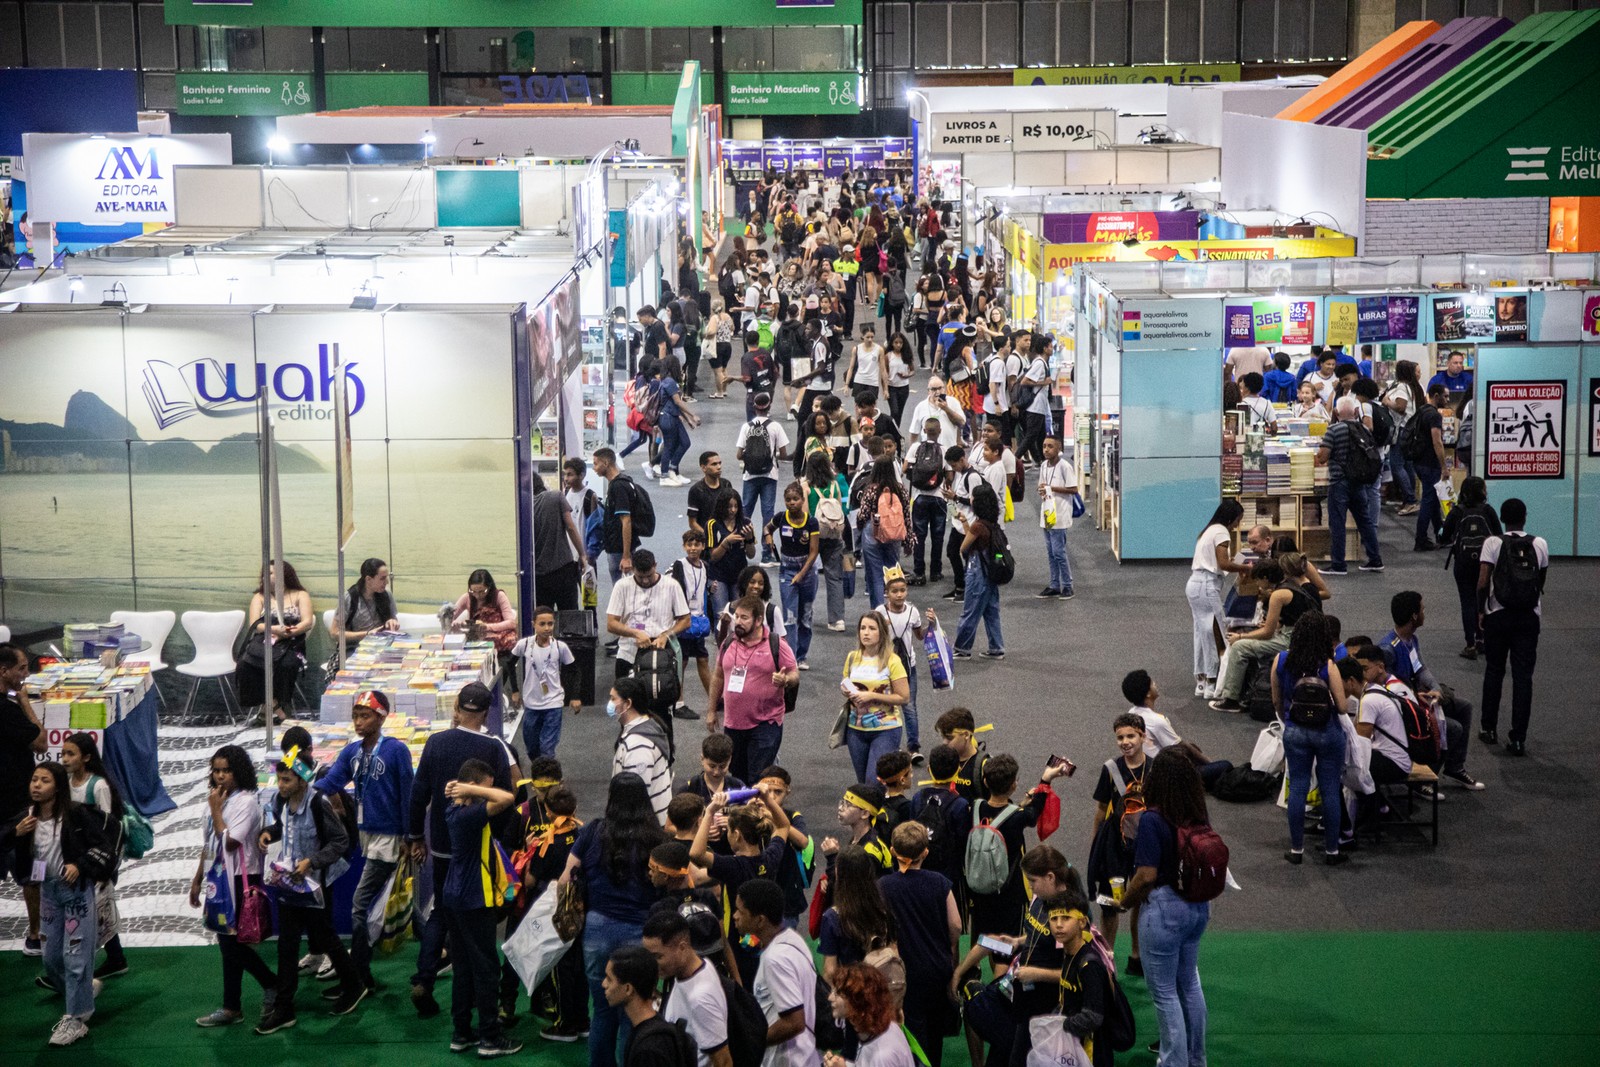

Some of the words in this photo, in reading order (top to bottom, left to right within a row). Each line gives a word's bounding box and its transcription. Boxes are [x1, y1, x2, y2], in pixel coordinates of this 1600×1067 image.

[182, 85, 225, 94] Banheiro
[227, 84, 271, 94] Feminino
[730, 85, 772, 94] Banheiro
[774, 84, 820, 94] Masculino
[945, 121, 987, 130] LIVROS
[988, 120, 998, 130] A
[1022, 125, 1042, 138] R$
[1045, 124, 1085, 139] 10,00
[942, 135, 984, 144] PARTIR
[985, 134, 1001, 144] DE
[102, 184, 158, 197] EDITORA
[94, 201, 168, 213] AVE-MARIA
[1289, 303, 1308, 313] 365
[1143, 311, 1188, 320] aquarelalivros
[1255, 311, 1282, 327] 365
[1358, 311, 1387, 321] LIBRAS
[1143, 321, 1188, 329] livrosaquarela
[1143, 331, 1211, 339] aquarelalivros.com.br
[1493, 388, 1516, 398] TOCAR
[1517, 388, 1527, 398] NA
[1529, 387, 1560, 399] COLEÇÃO
[277, 403, 335, 421] editor
[1491, 453, 1508, 462] PODE
[1509, 453, 1535, 462] CAUSAR
[1536, 452, 1559, 462] SÉRIOS
[1491, 463, 1531, 472] PROBLEMAS
[1532, 462, 1558, 472] FÍSICOS
[1061, 1056, 1075, 1067] DCL
